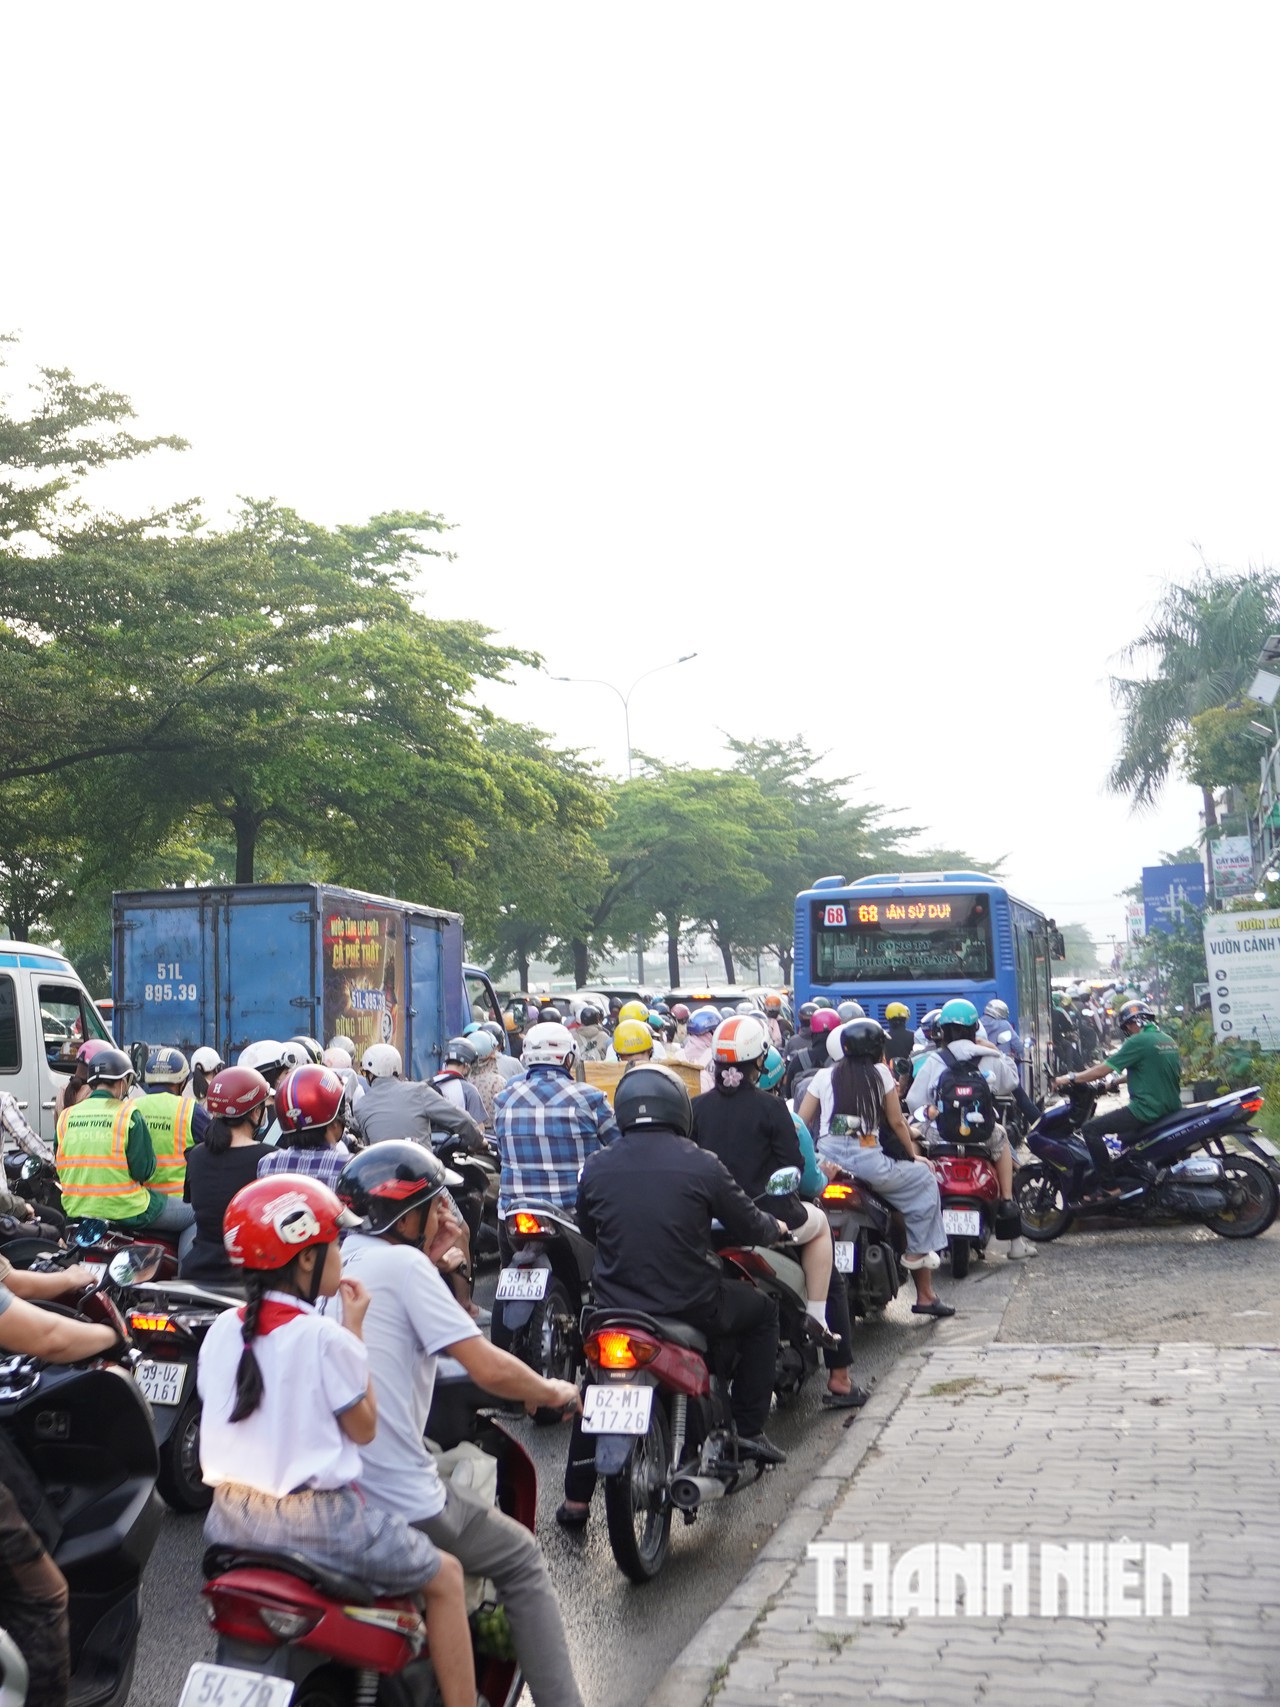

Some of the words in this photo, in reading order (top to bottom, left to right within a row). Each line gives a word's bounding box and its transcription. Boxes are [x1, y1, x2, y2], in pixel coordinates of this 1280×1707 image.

[827, 907, 844, 924] 68
[858, 904, 878, 922] 68
[1210, 938, 1241, 955] VƯỜN
[1244, 935, 1275, 952] CẢNH
[157, 963, 183, 980] 51L
[145, 984, 197, 1002] 895.39
[68, 1121, 89, 1129] THANH
[506, 1271, 541, 1284] 59-K2
[142, 1364, 179, 1383] 59-U2
[139, 1381, 178, 1401] 21.61
[595, 1389, 640, 1408] 62-M1
